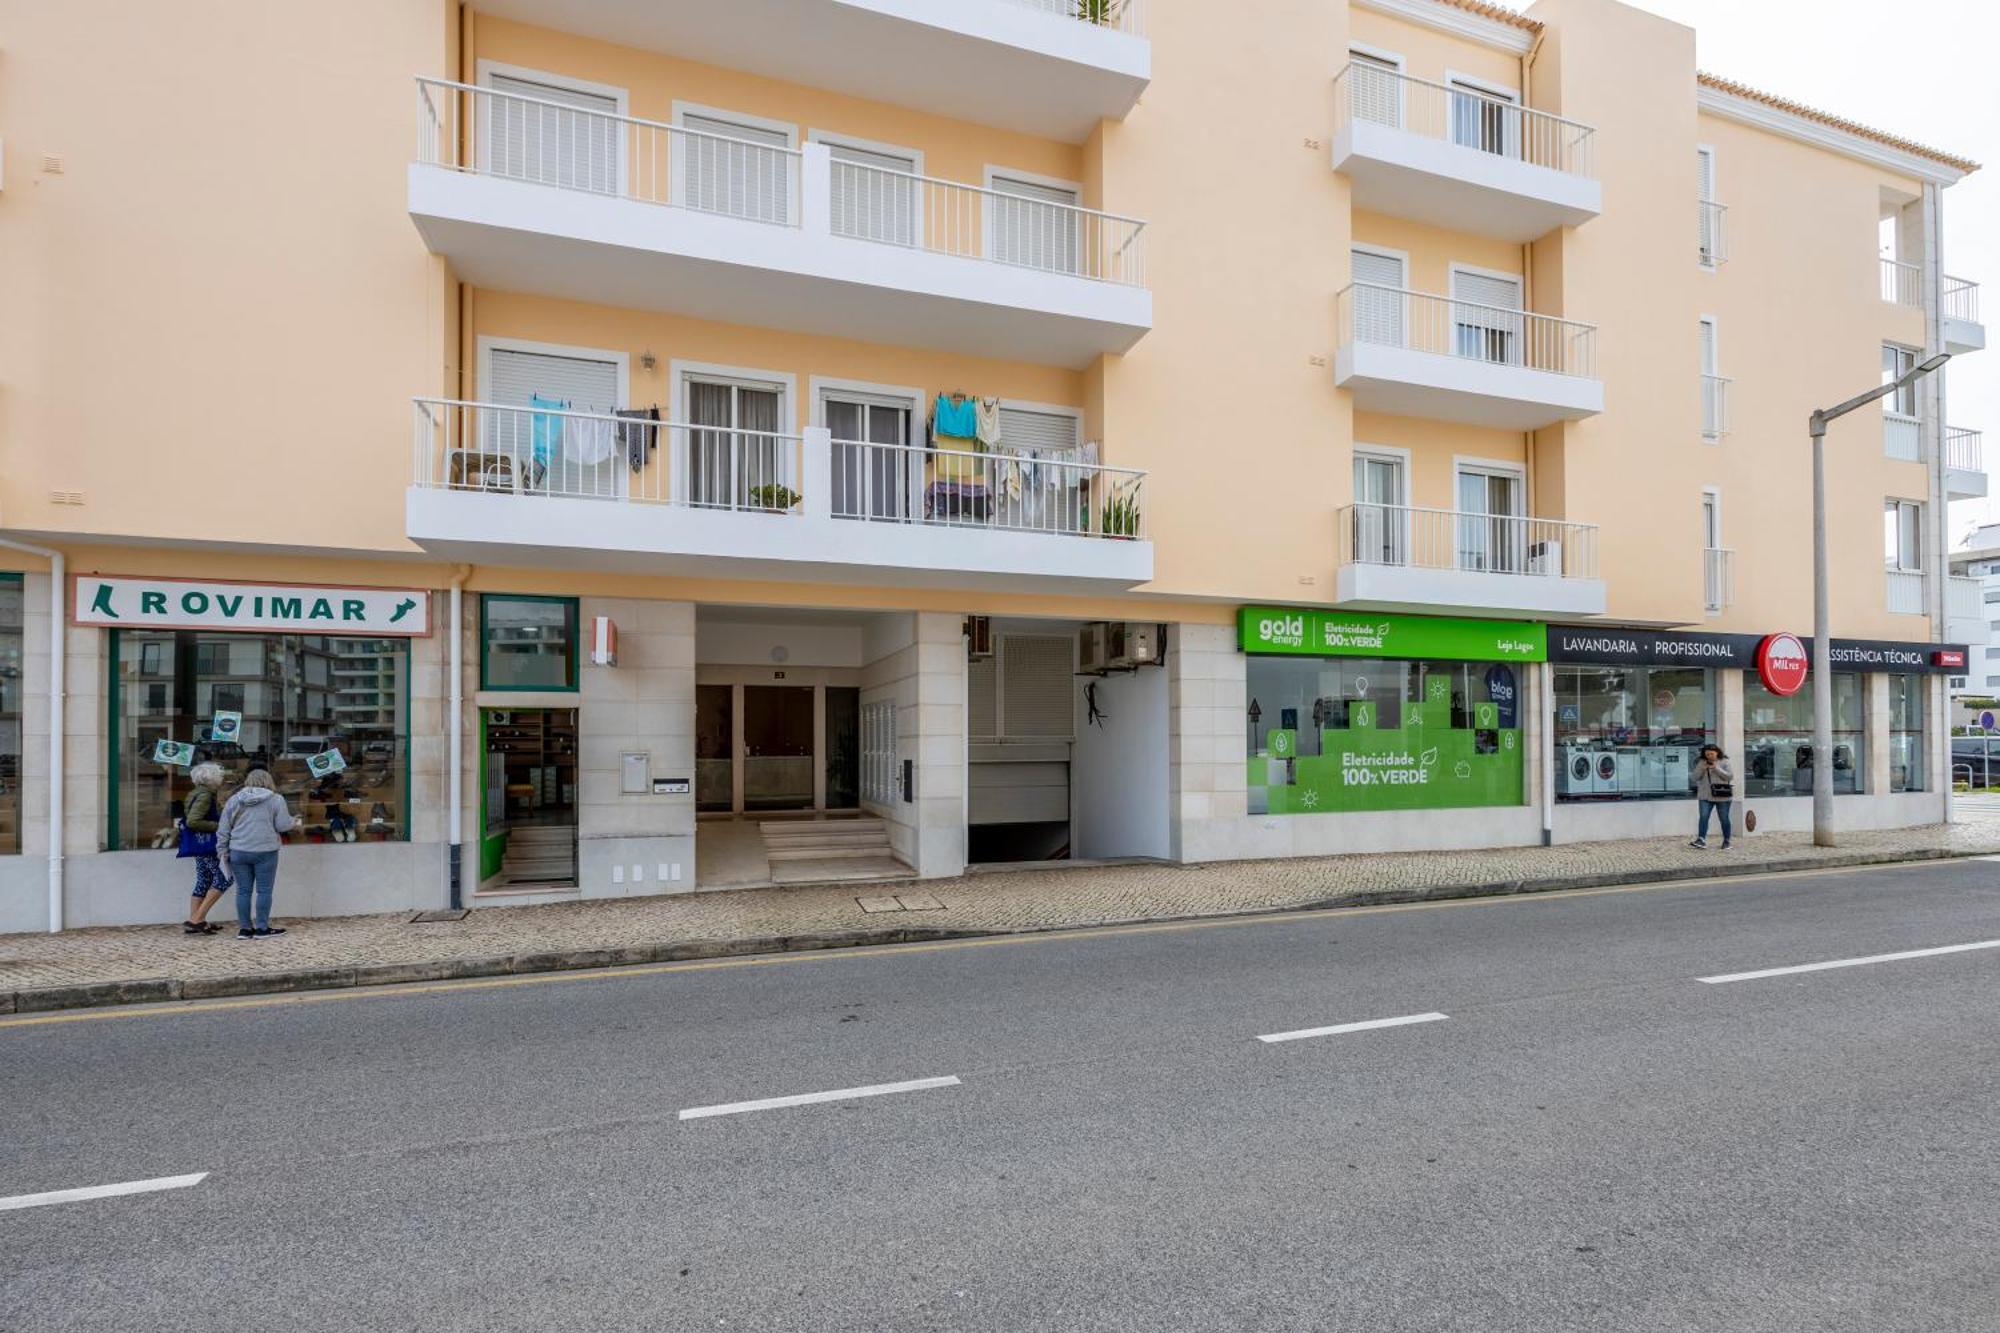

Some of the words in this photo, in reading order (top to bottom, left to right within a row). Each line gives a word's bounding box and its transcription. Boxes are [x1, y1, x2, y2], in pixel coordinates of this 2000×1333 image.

[141, 591, 367, 621] ROVIMAR
[1259, 615, 1304, 641] gold
[1324, 622, 1374, 635] Eletricidade
[1272, 636, 1304, 647] energy
[1324, 634, 1349, 647] 100%
[1350, 636, 1384, 649] VERDE
[1563, 637, 1638, 654] LAVANDARIA
[1655, 641, 1734, 657] PROFISSIONAL
[1829, 647, 1883, 663] SSISTÊNCIA
[1884, 648, 1924, 665] TÉCNICA
[1342, 751, 1415, 767] Eletricidade
[1342, 768, 1379, 786] 100%
[1380, 769, 1428, 785] VERDE
